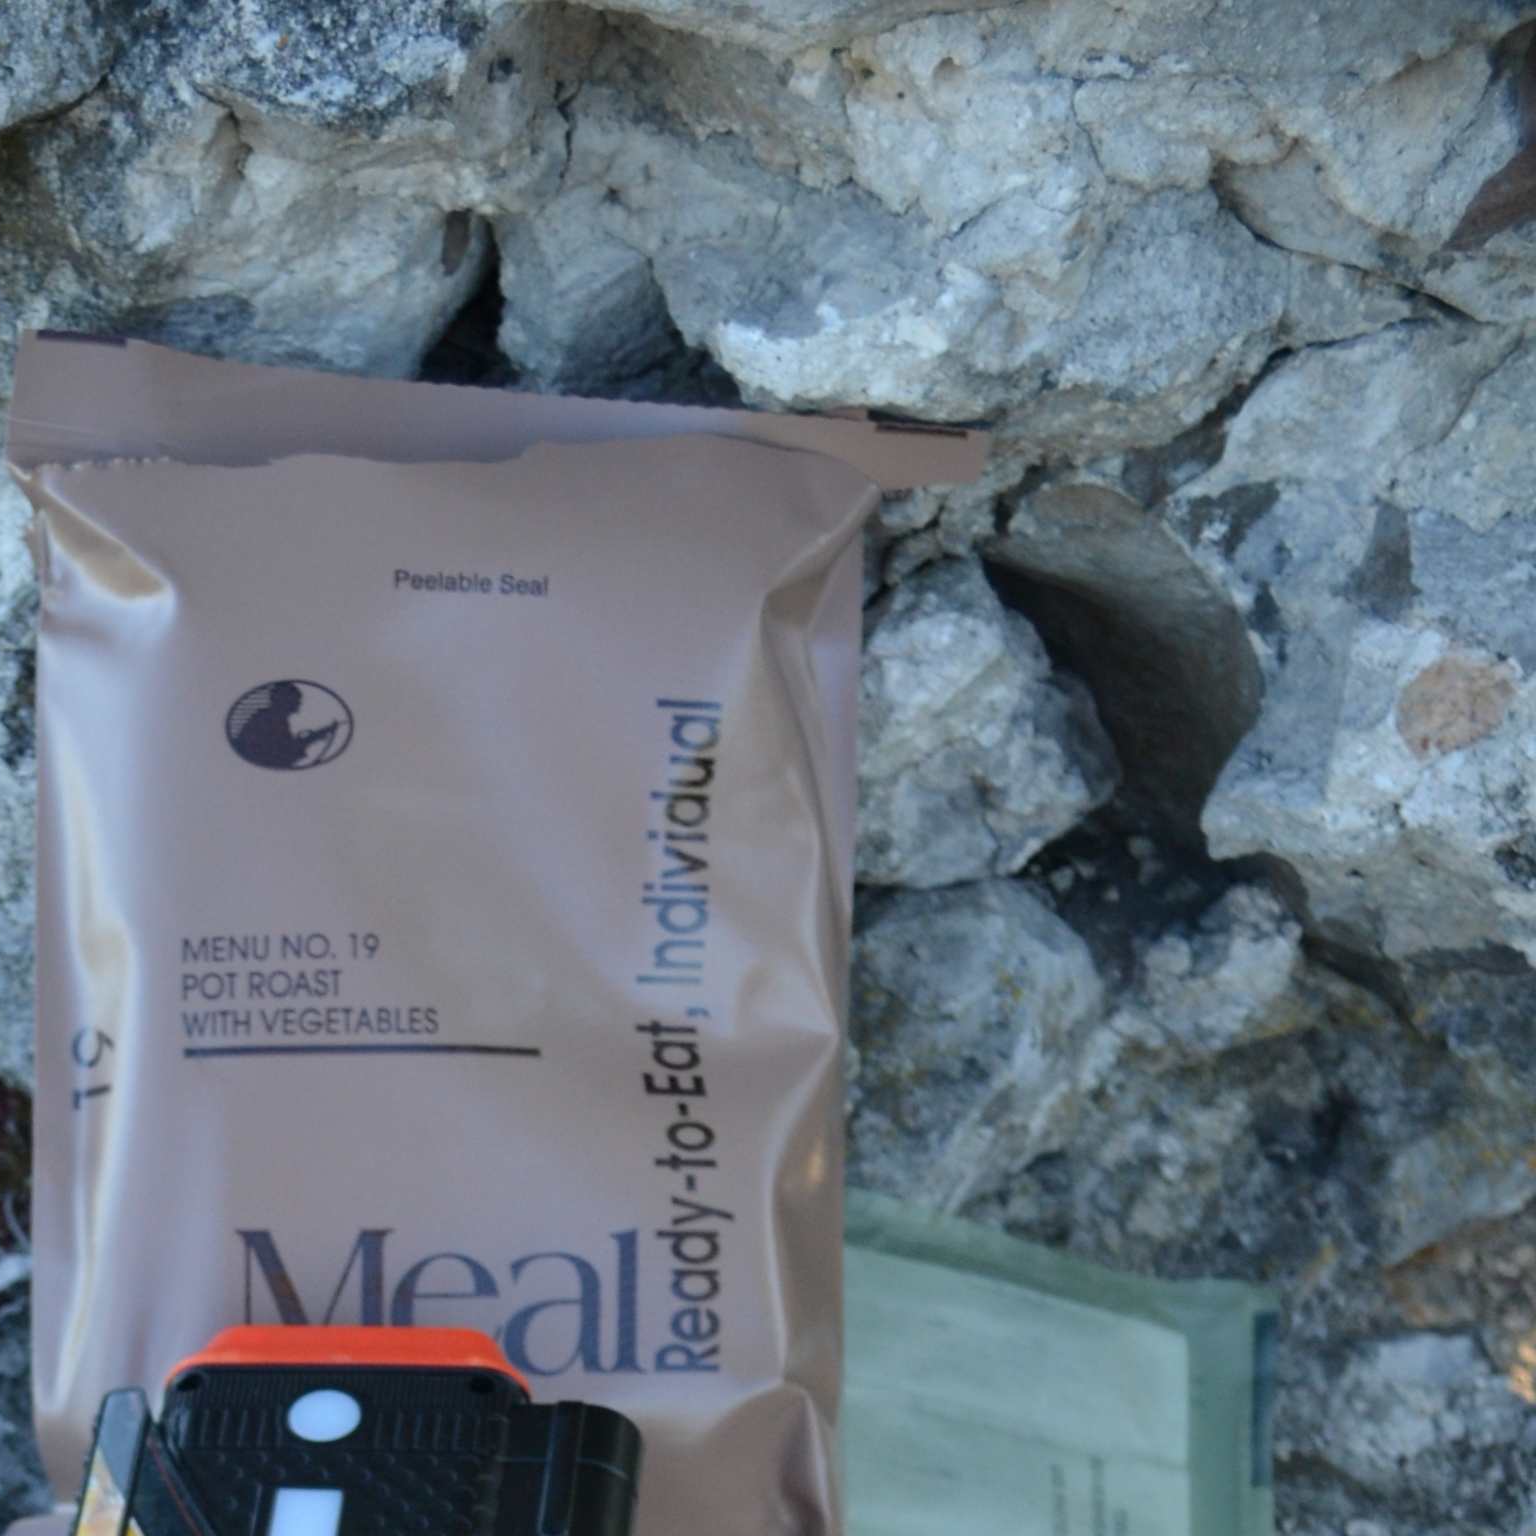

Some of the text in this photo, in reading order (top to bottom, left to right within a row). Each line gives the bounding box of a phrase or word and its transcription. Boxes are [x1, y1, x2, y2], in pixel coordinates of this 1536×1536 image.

[392, 565, 550, 598] Peelable Seal
[181, 932, 380, 964] MENU NO. 19
[181, 969, 343, 1001] POT ROAST
[181, 1007, 440, 1039] WITH VEGETABLES
[636, 697, 735, 1374] Ready-to-Eat, Individual
[235, 1227, 648, 1377] Meal
